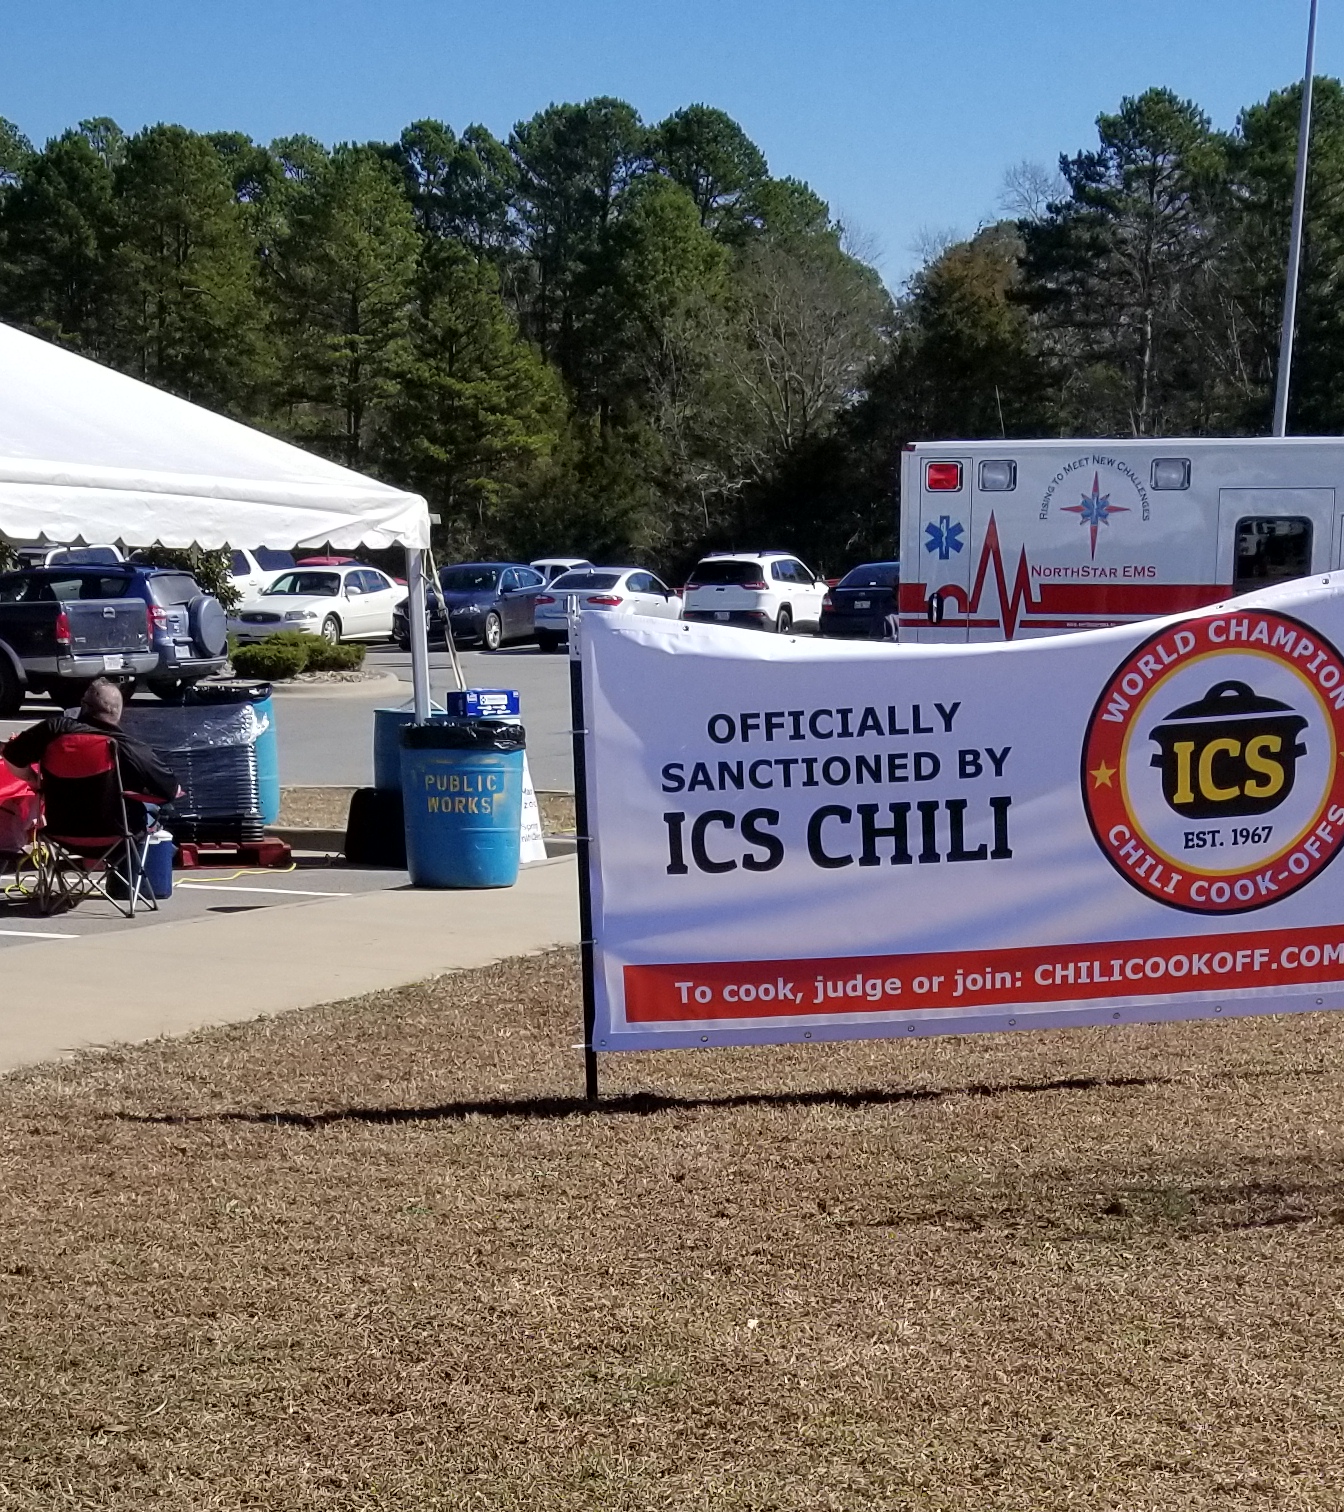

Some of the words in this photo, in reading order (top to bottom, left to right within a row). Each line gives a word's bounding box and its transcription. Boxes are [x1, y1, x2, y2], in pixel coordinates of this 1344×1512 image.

[1062, 457, 1090, 476] MEET
[1092, 454, 1117, 467] NEW
[1122, 565, 1156, 578] EMS
[1102, 630, 1196, 723] WORLD
[707, 701, 961, 744] OFFICIALLY
[425, 775, 497, 793] PUBLIC
[661, 751, 941, 793] SANCTIONED
[958, 746, 1012, 779] BY
[1173, 735, 1285, 804] ICS
[427, 797, 491, 814] WORKS
[663, 806, 785, 875] ICS
[806, 795, 1013, 869] CHILI
[1183, 830, 1225, 849] EST.
[1231, 826, 1274, 845] 1967
[1108, 824, 1183, 895] CHILI
[674, 981, 713, 1004] To
[722, 977, 804, 1004] cook,
[812, 973, 903, 1004] judge
[912, 973, 945, 994] or
[952, 966, 1023, 997] join:
